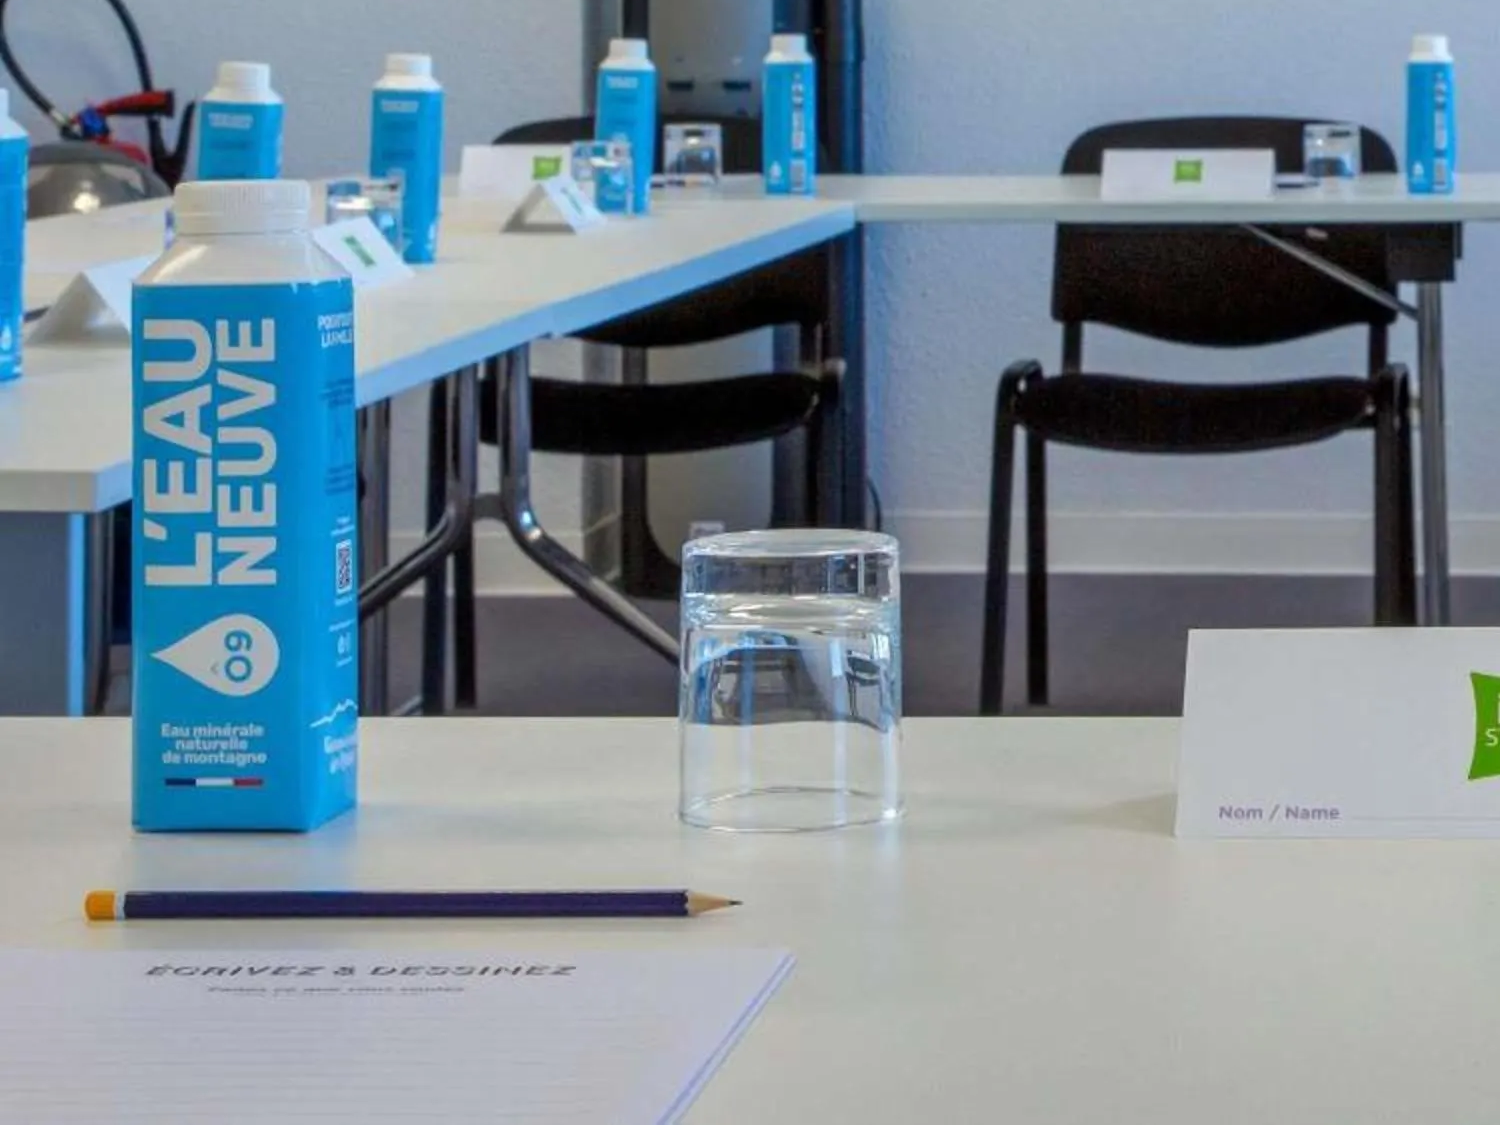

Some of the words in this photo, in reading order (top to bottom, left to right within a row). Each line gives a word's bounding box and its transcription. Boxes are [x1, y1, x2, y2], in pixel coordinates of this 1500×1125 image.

[143, 319, 213, 586] L'EAU
[215, 317, 277, 586] NEUVE
[161, 723, 190, 737] Eau
[193, 722, 265, 737] minérale
[175, 736, 249, 751] naturelle
[162, 750, 181, 764] de
[184, 751, 268, 767] montagne
[1218, 805, 1263, 821] Nom
[1285, 805, 1341, 821] Name
